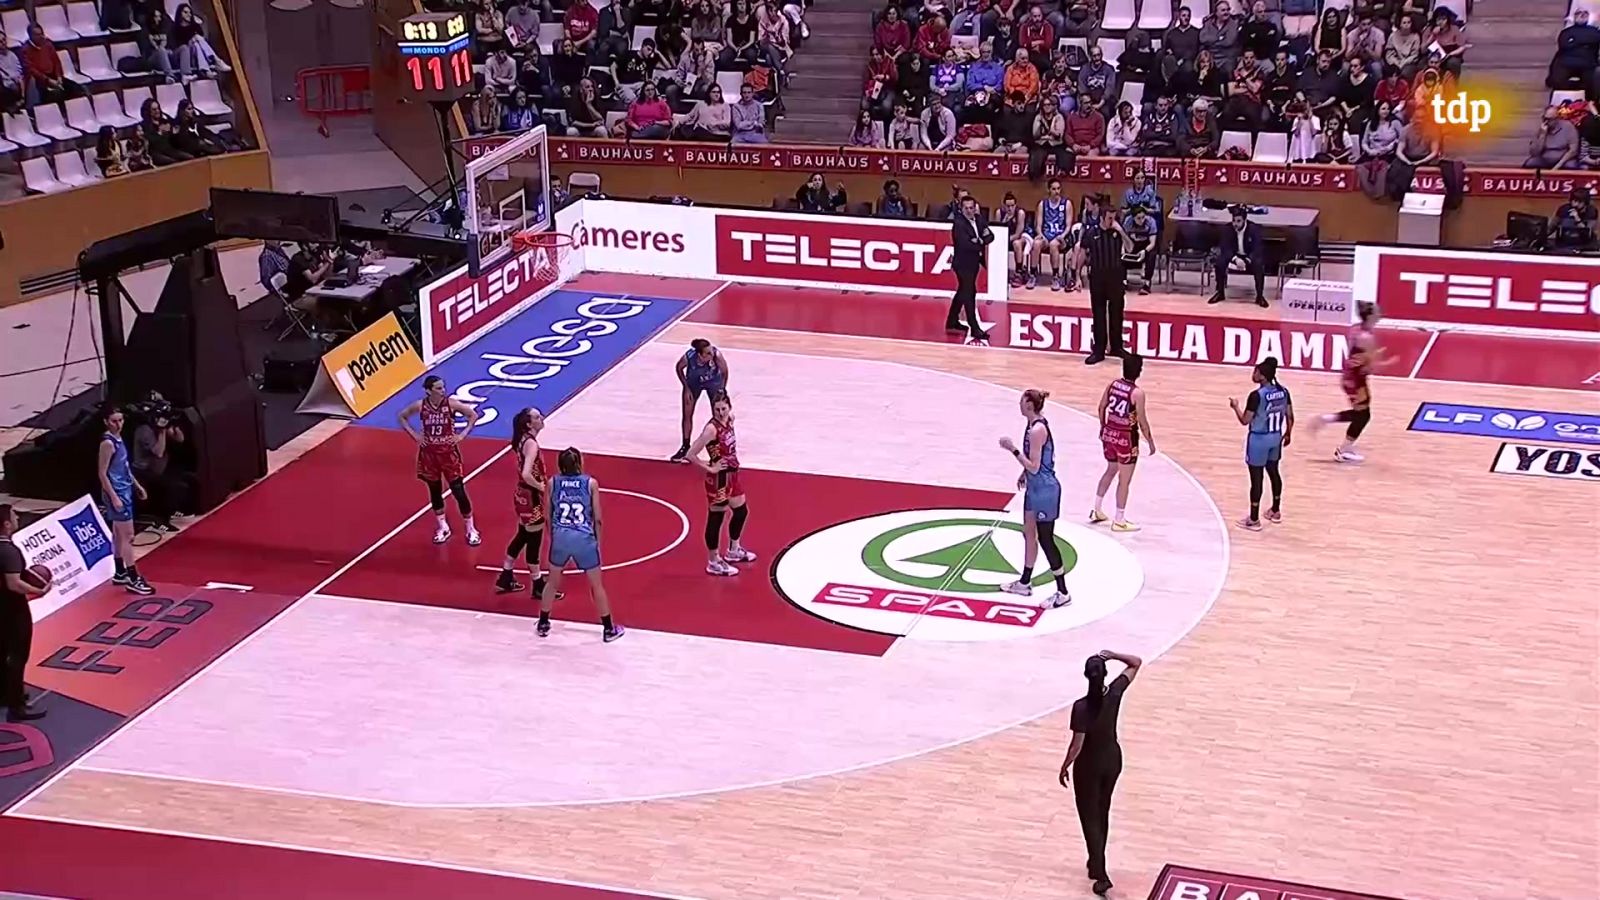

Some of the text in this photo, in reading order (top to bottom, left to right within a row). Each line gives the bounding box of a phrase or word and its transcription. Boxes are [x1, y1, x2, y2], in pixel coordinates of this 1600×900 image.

[407, 56, 444, 90] 11
[451, 49, 471, 87] 11
[579, 146, 655, 161] BAUHAUS
[685, 150, 761, 166] BAUHAUS
[792, 153, 869, 168] BAUHAUS
[901, 158, 979, 173] BAUHAUS
[1240, 170, 1324, 186] BAUHAUS
[1483, 177, 1575, 194] BAUHAUS
[571, 221, 686, 253] Càmeres
[438, 247, 552, 332] TELECTA
[348, 330, 410, 391] parlem
[1108, 395, 1128, 418] 24
[1423, 410, 1484, 424] LF
[431, 425, 443, 436] 13
[1268, 410, 1281, 432] 11
[559, 502, 585, 525] 23
[20, 528, 57, 552] HOTEL
[72, 521, 98, 543] ibis
[31, 543, 66, 566] GIRONA
[79, 533, 106, 554] budget
[824, 585, 1039, 625] SPAR
[37, 597, 214, 675] FEB
